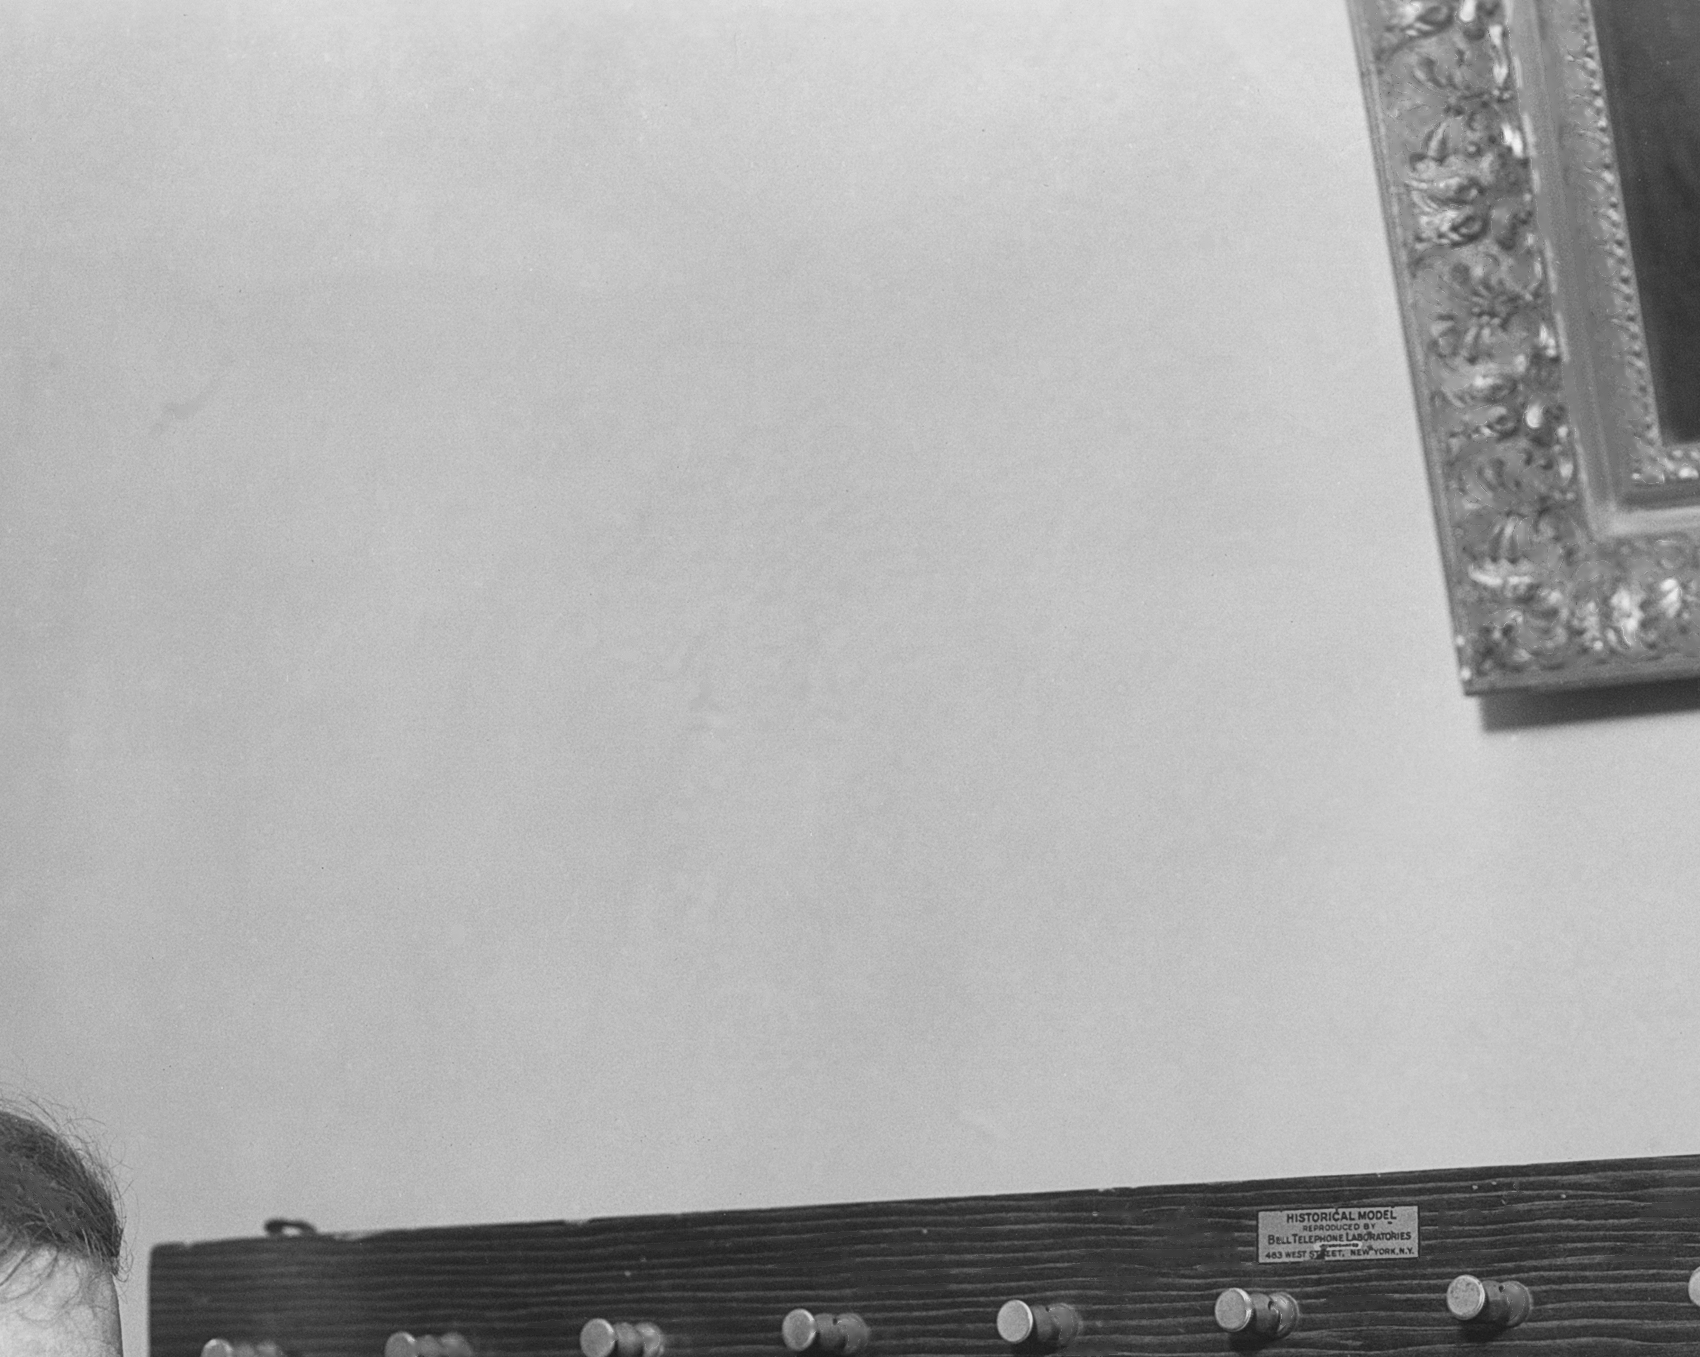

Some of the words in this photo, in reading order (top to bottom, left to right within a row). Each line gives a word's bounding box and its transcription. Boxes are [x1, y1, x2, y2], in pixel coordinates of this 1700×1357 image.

[1286, 1211, 1355, 1223] HISTORICAL
[1357, 1209, 1397, 1221] MODEL
[1302, 1223, 1360, 1233] REPRODUCED
[1363, 1222, 1376, 1231] BY
[1291, 1232, 1344, 1244] TELEPHONE
[1345, 1230, 1411, 1242] LABORATORIES
[1284, 1250, 1307, 1259] WEST
[1350, 1248, 1370, 1257] NEW
